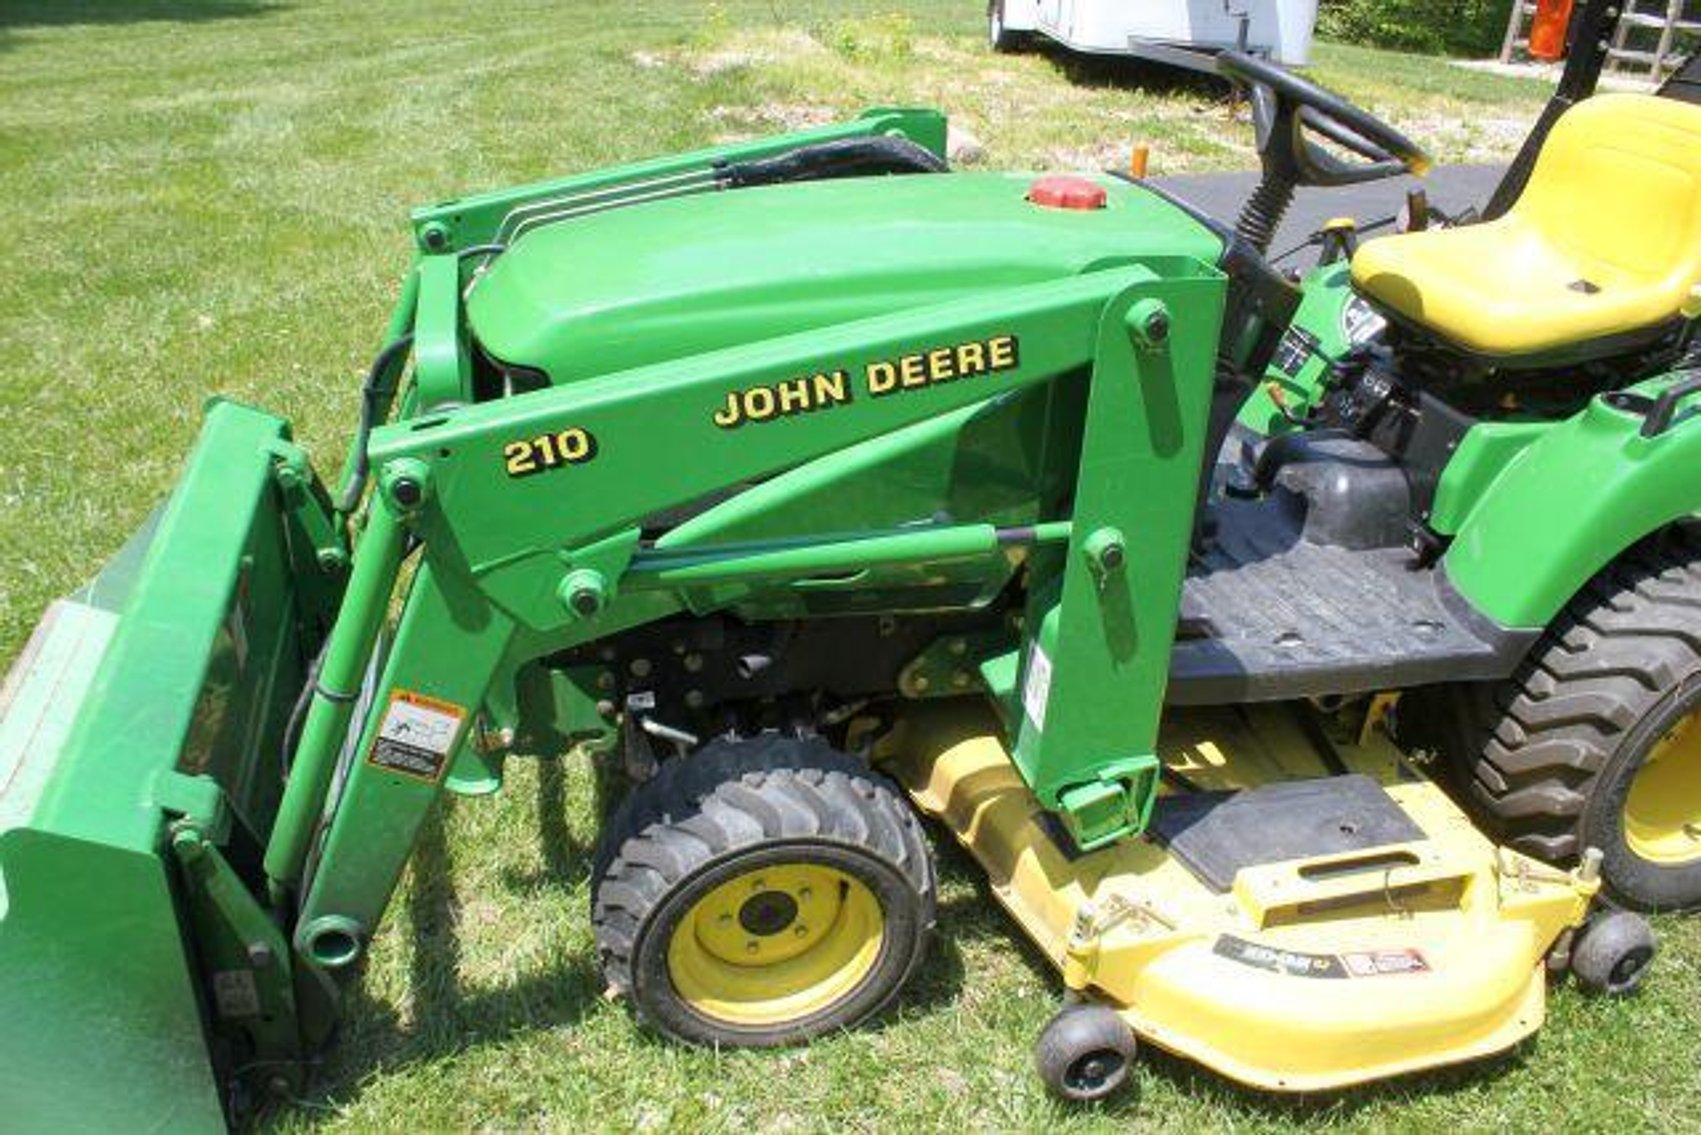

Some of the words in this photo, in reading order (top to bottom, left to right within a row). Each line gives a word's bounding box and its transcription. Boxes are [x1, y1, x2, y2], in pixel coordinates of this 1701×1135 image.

[714, 371, 851, 426] JOHN
[867, 336, 1017, 396] DEERE
[504, 427, 596, 477] 210
